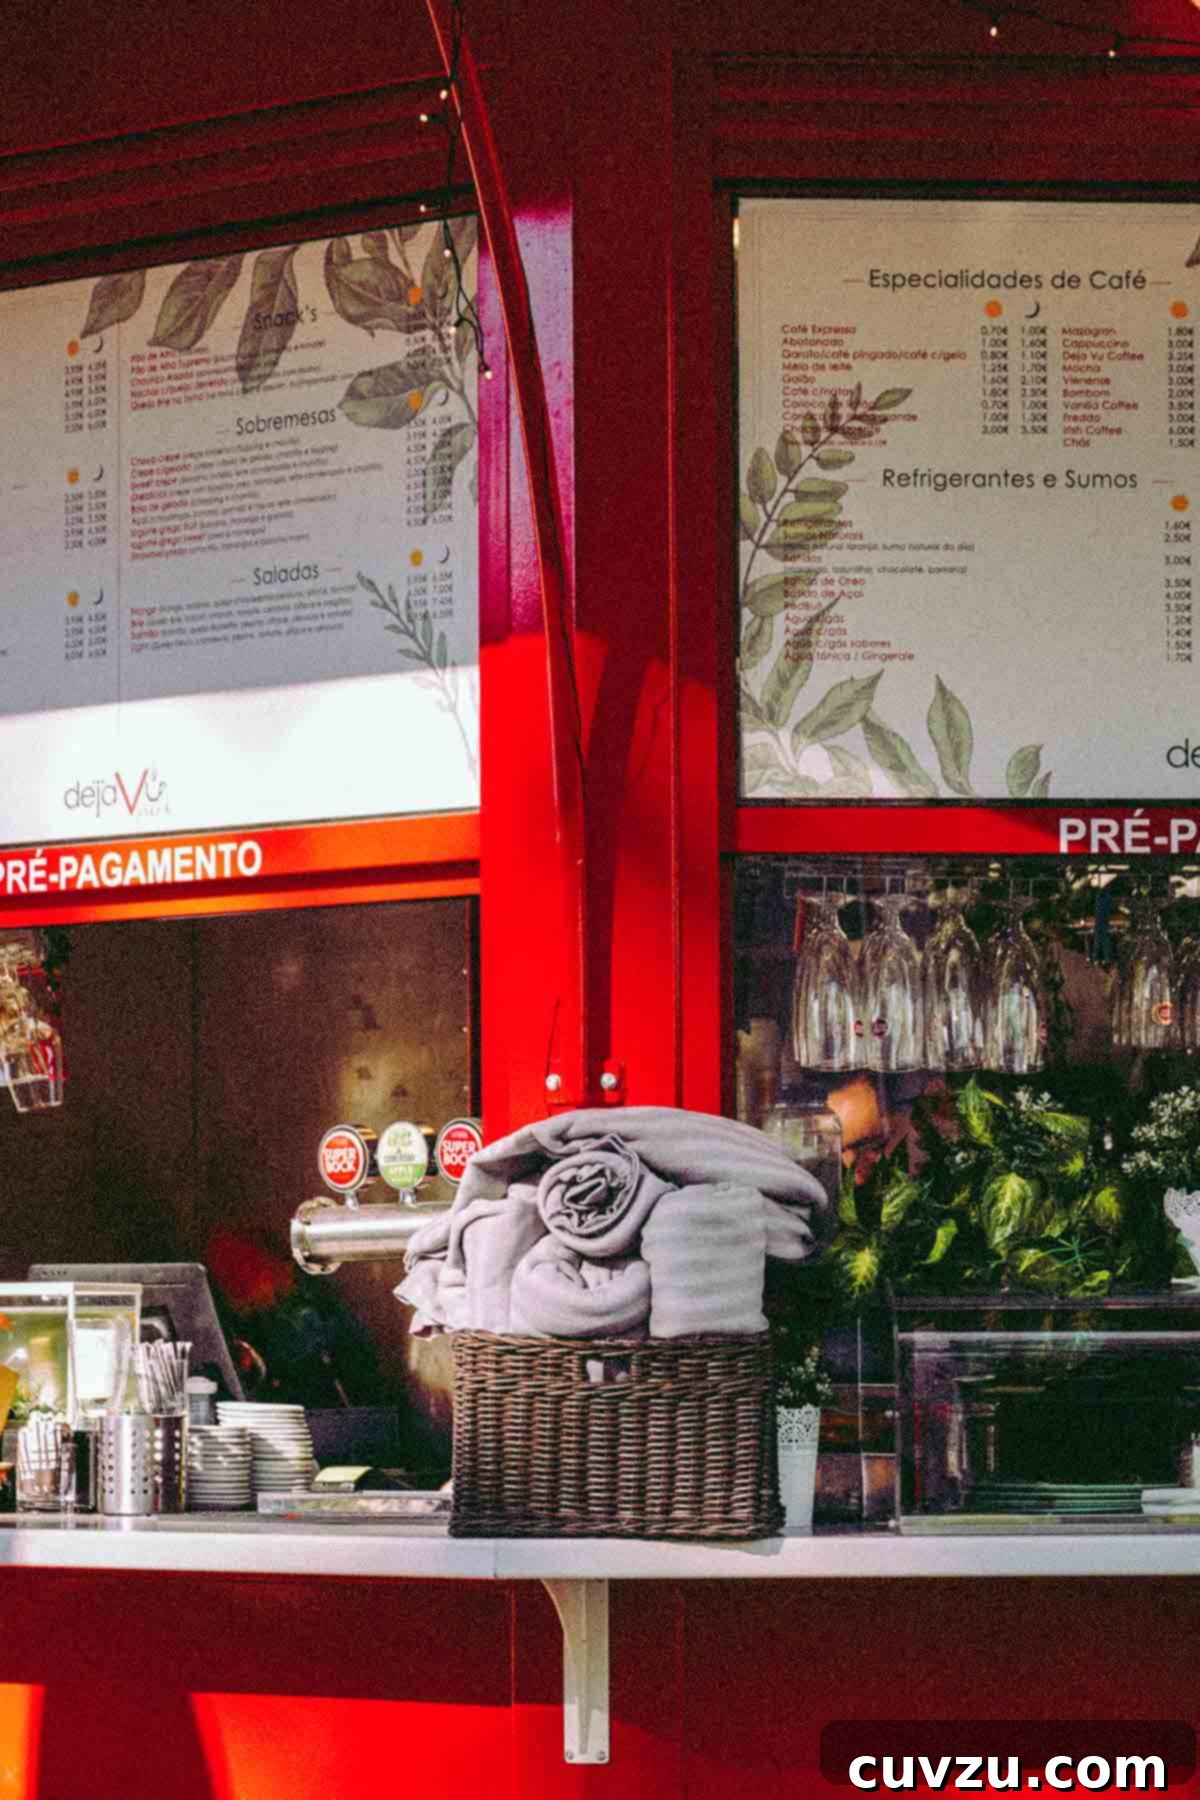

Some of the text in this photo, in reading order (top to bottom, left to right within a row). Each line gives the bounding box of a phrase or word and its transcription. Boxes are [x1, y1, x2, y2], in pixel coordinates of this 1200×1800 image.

[869, 269, 1147, 293] Especialidades de Café
[781, 324, 1048, 336] Café Expresso 0.70€ 1.00€
[1061, 327, 1116, 338] Mazagran
[781, 336, 844, 346] Abatanado
[982, 339, 1008, 348] 1.00€
[1062, 339, 1130, 350] Cappuccino
[1107, 351, 1144, 361] Coffee
[811, 362, 826, 371] de
[1021, 363, 1048, 372] 1.70€
[1062, 363, 1101, 373] Mocha
[1021, 376, 1048, 385] 2.10€
[782, 387, 807, 396] Café
[1167, 389, 1195, 398] 2.00€
[980, 401, 1008, 410] 0.70€
[1021, 401, 1048, 410] 1.00€
[1102, 400, 1139, 410] Coffee
[235, 409, 336, 436] Sobremesas
[982, 413, 1008, 422] 1.00€
[980, 426, 1008, 434] 3.00€
[1086, 425, 1122, 435] Coffee
[1167, 440, 1195, 448] 1.50€
[882, 468, 1138, 492] Refrigerantes e Sumos
[1164, 533, 1192, 543] 2.50€
[252, 562, 320, 586] Saladas
[1059, 808, 1200, 854] PRÉ-P
[0, 840, 263, 895] RÉ-PAGAMENTO
[443, 1140, 476, 1154] SUPER
